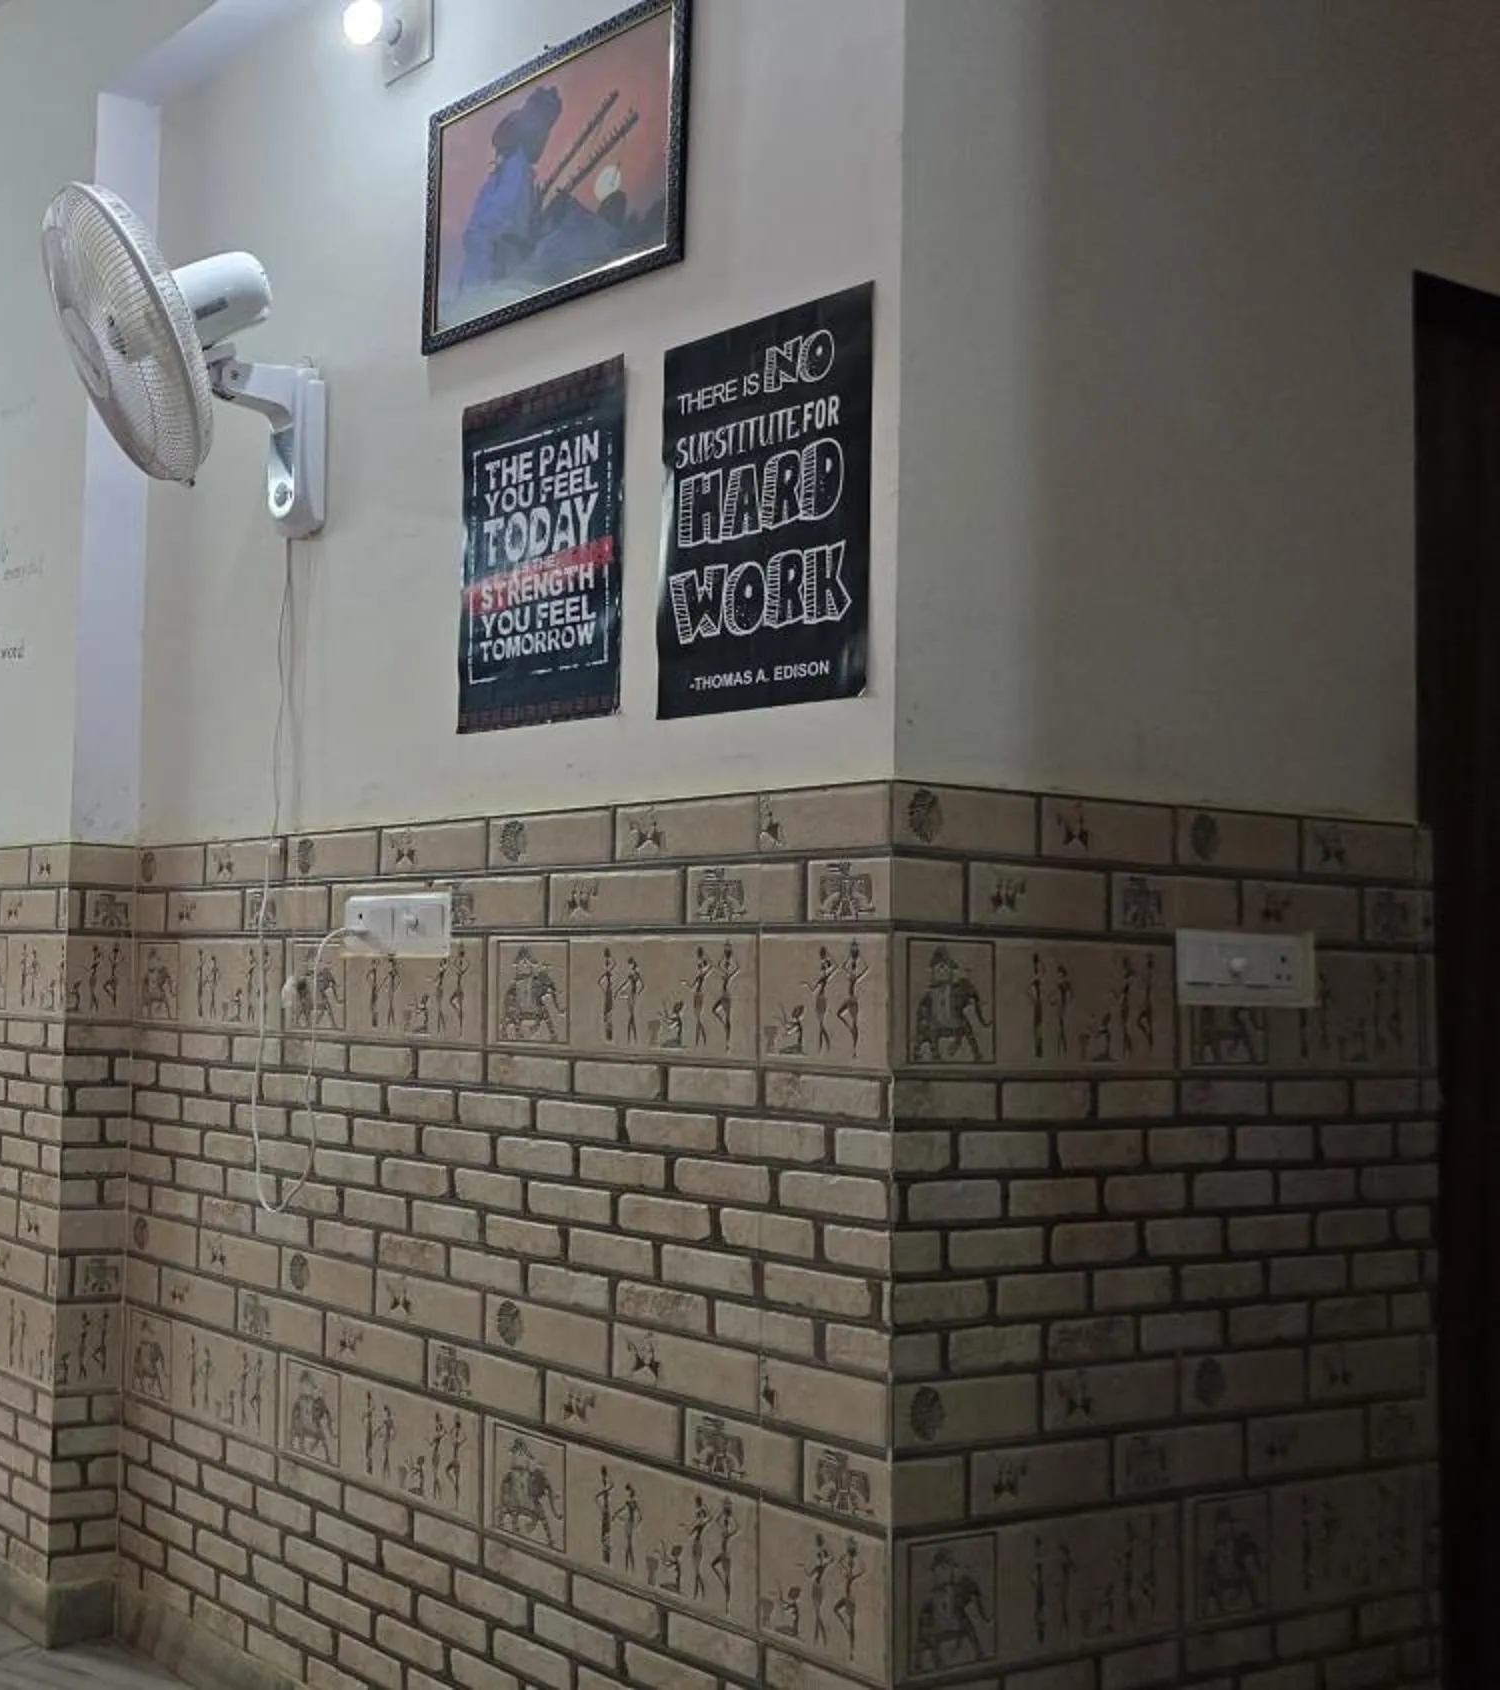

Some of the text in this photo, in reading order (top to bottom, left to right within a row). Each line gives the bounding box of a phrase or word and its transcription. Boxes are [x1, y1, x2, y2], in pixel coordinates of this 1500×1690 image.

[677, 329, 835, 416] THERE IS NO
[485, 429, 599, 490] THE PAIN
[676, 395, 840, 469] SUBSTITUTE FOR
[484, 465, 599, 517] YOU FEEL
[677, 437, 845, 549] HARD
[483, 491, 599, 567] TODAY
[481, 562, 595, 610] STRENGTH
[481, 594, 597, 639] YOU FEEL
[669, 540, 852, 645] WORK
[480, 621, 596, 662] TOMORROW
[689, 659, 830, 691] -THOMAS A. EDISON
